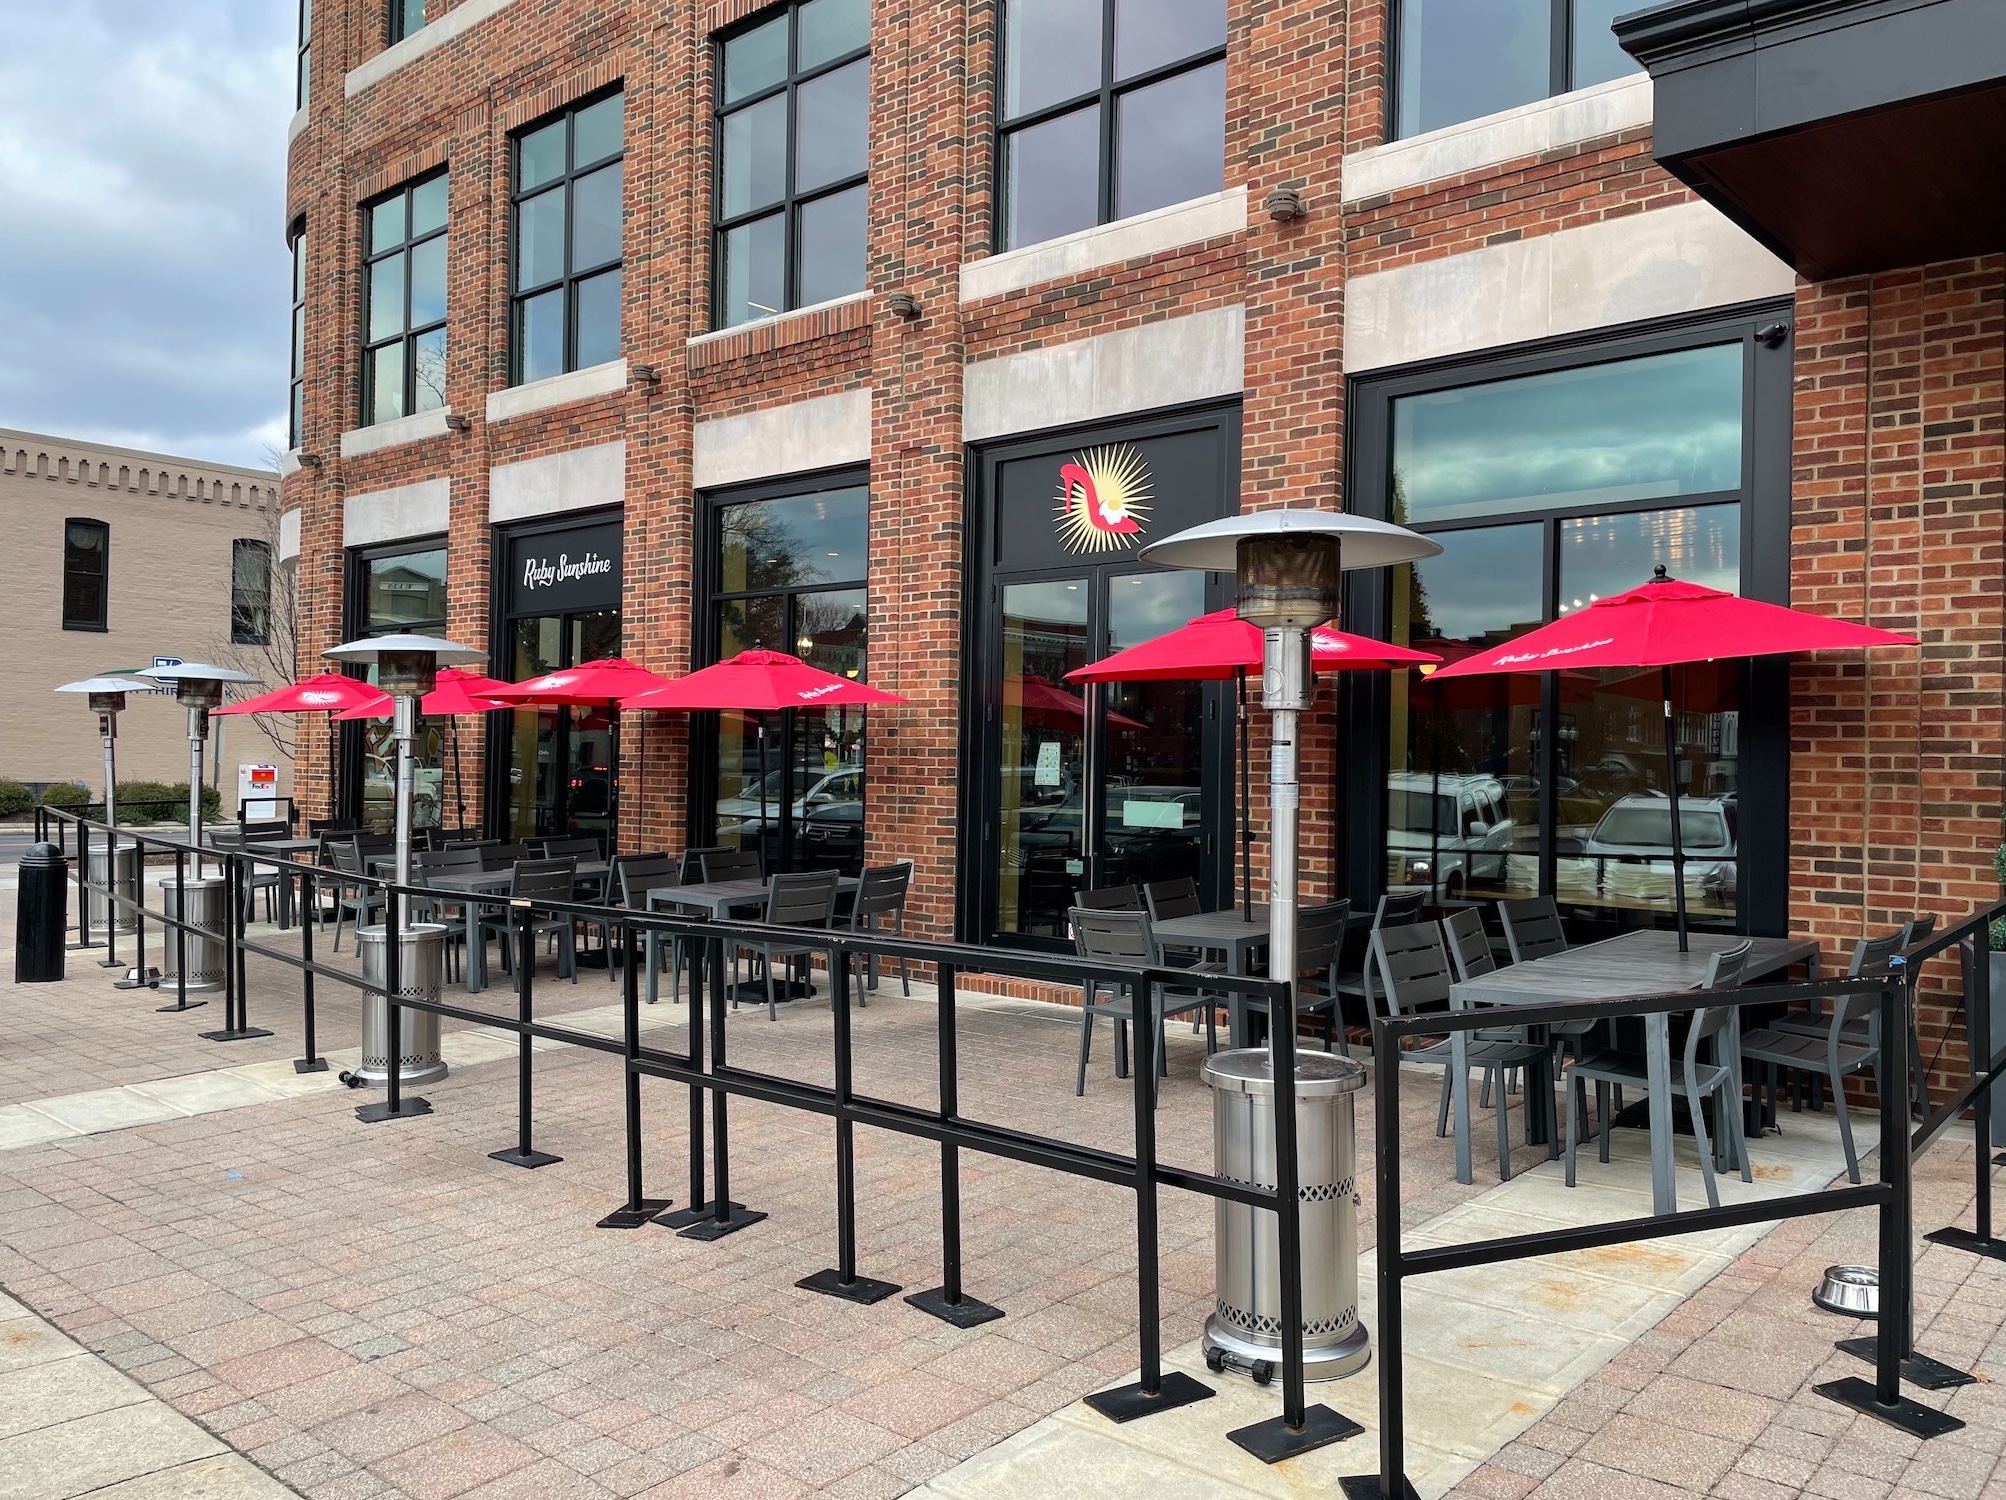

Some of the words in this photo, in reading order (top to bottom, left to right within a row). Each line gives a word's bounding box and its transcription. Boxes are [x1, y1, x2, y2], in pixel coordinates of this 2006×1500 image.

[523, 558, 556, 590] Ruby
[556, 552, 612, 582] Sunshine
[147, 686, 178, 696] THIR
